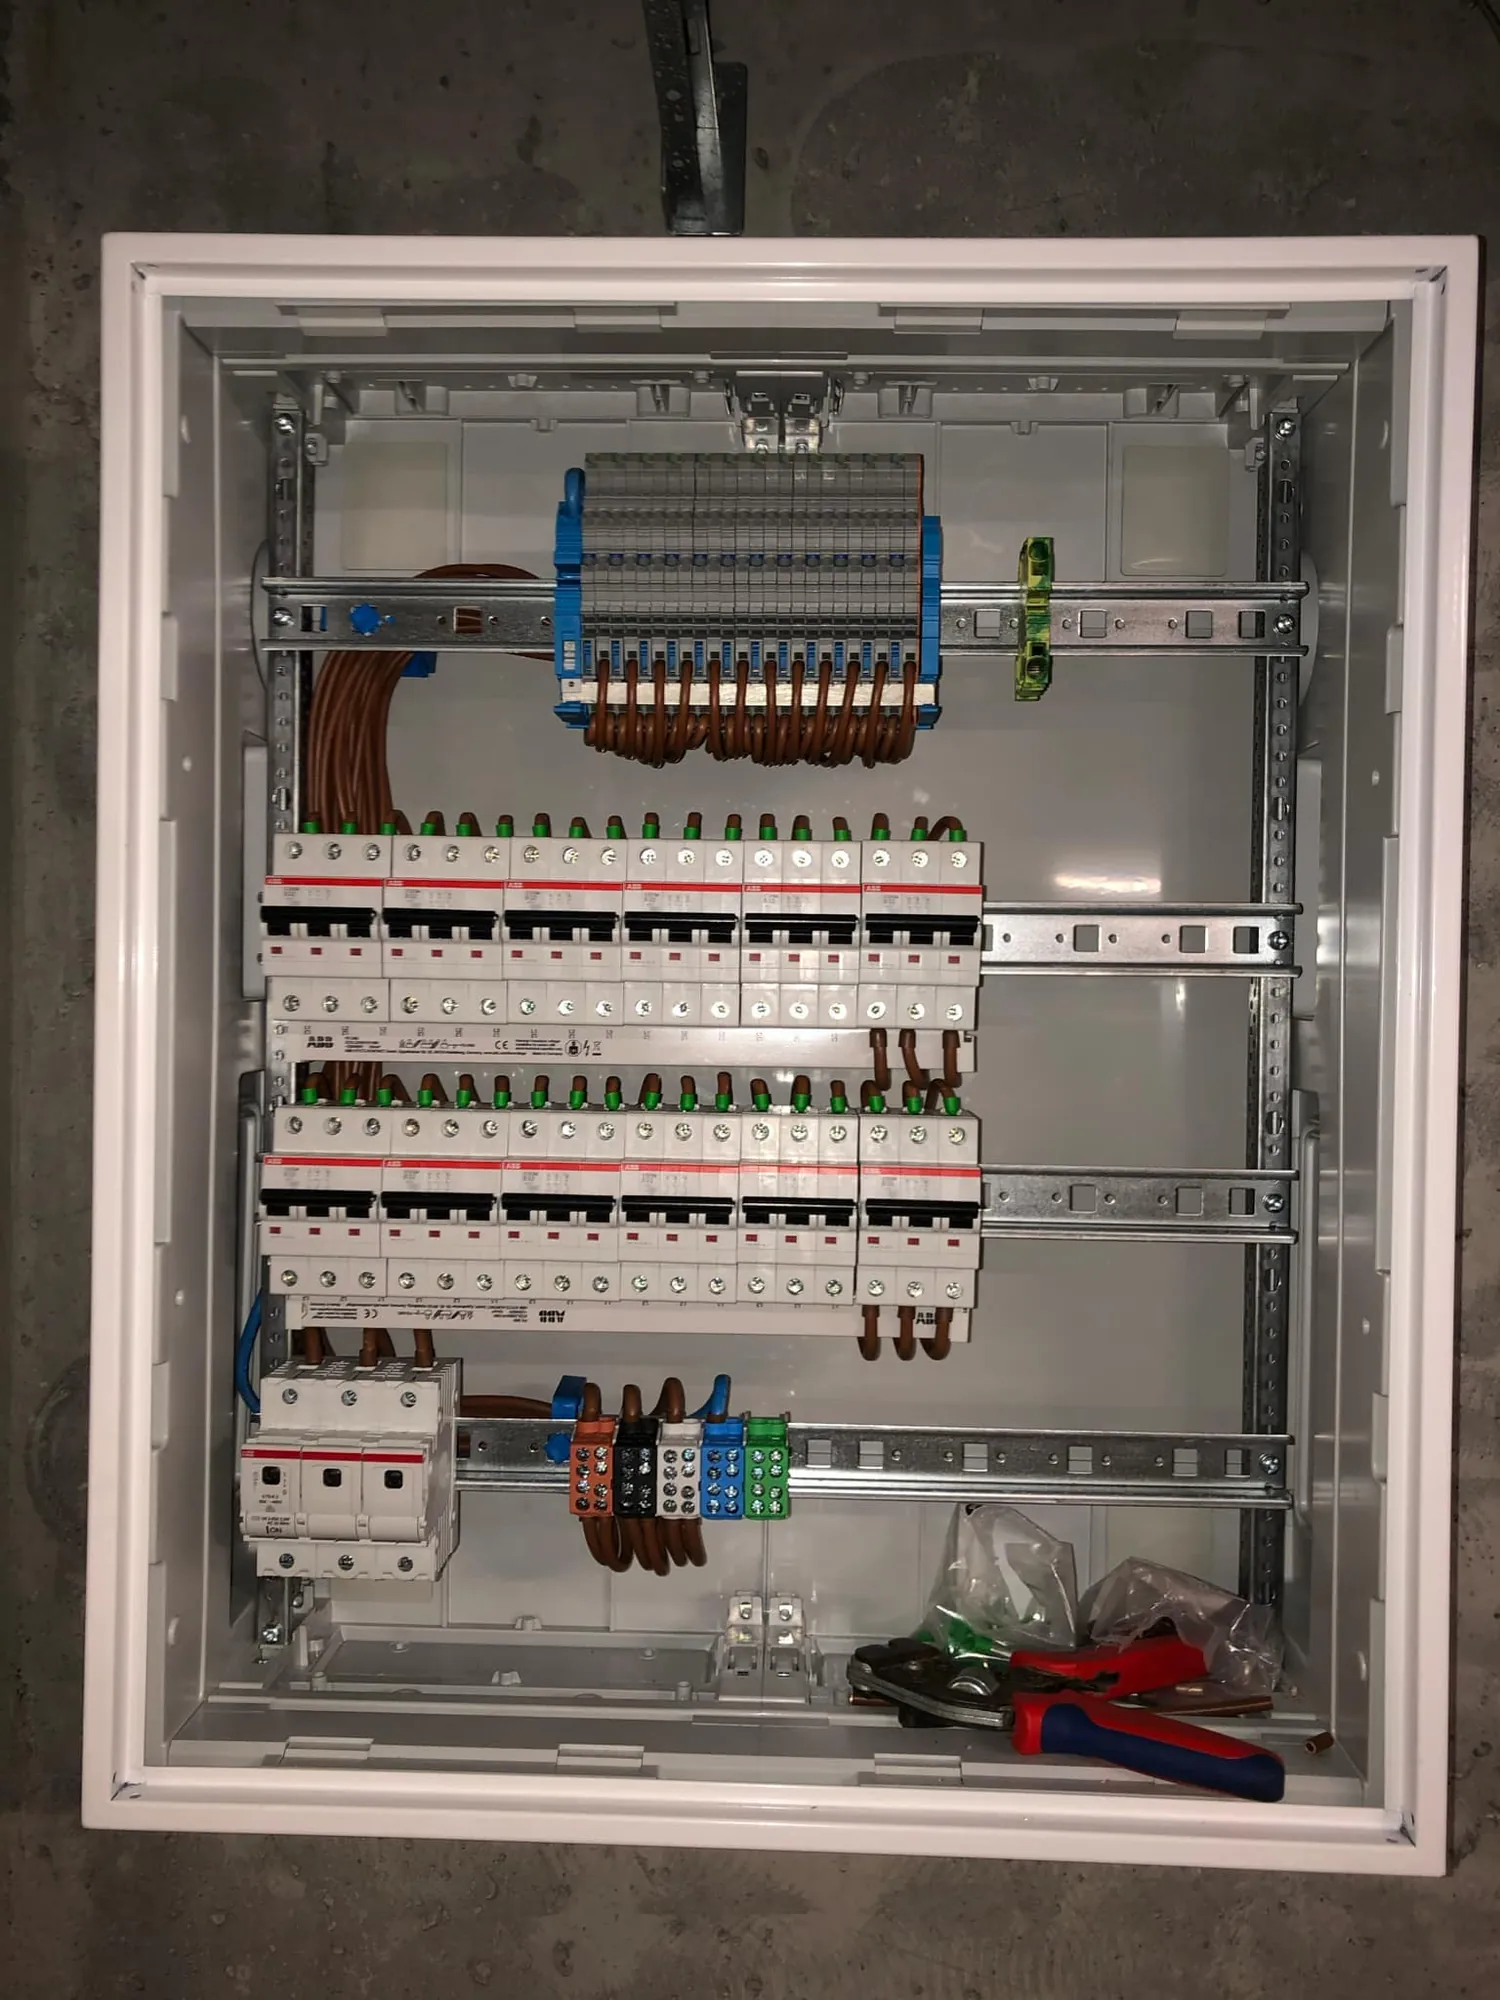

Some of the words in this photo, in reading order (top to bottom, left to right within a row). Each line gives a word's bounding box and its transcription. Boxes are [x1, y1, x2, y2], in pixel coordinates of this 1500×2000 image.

[306, 1036, 334, 1048] ABB
[494, 1040, 509, 1050] CE
[538, 1310, 565, 1323] ABB
[916, 1312, 936, 1325] AB
